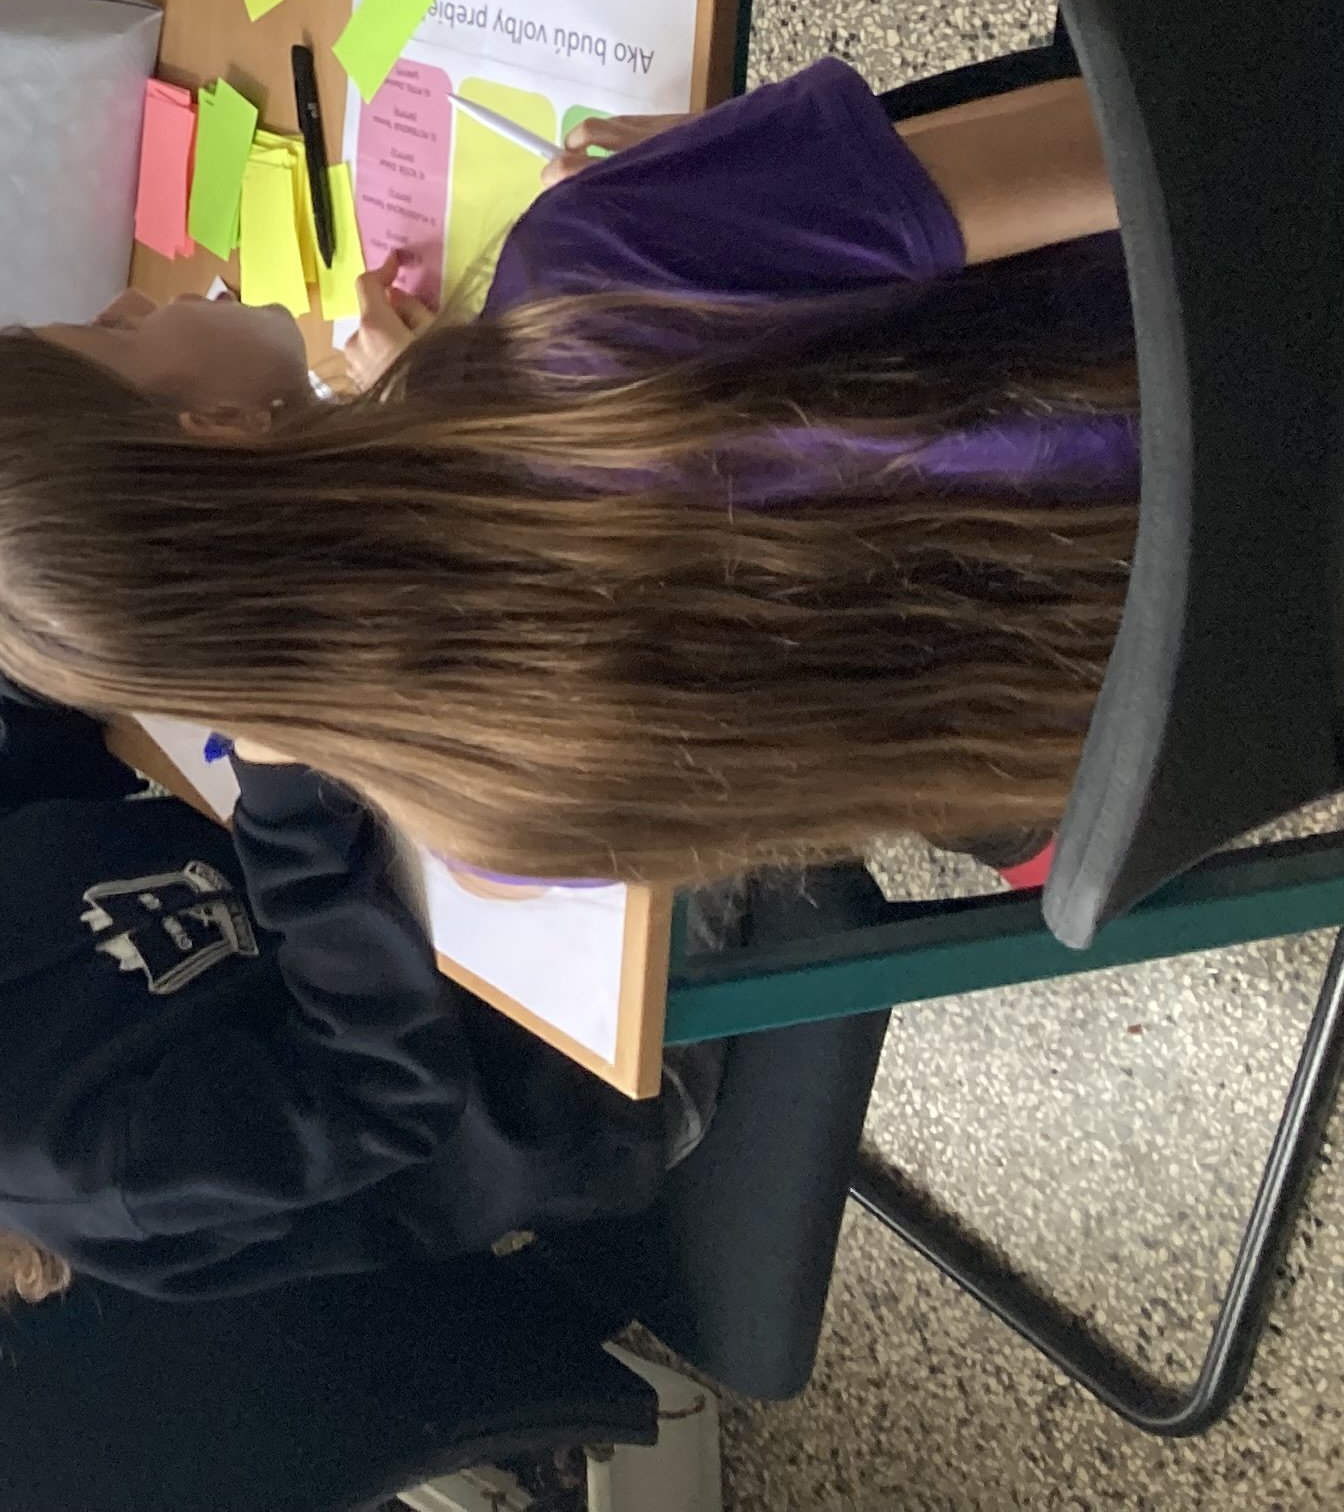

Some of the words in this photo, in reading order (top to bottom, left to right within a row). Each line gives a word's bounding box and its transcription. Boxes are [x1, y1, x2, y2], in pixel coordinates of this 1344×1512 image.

[492, 7, 548, 52] voľby
[552, 27, 606, 67] budú
[612, 41, 654, 78] Ako
